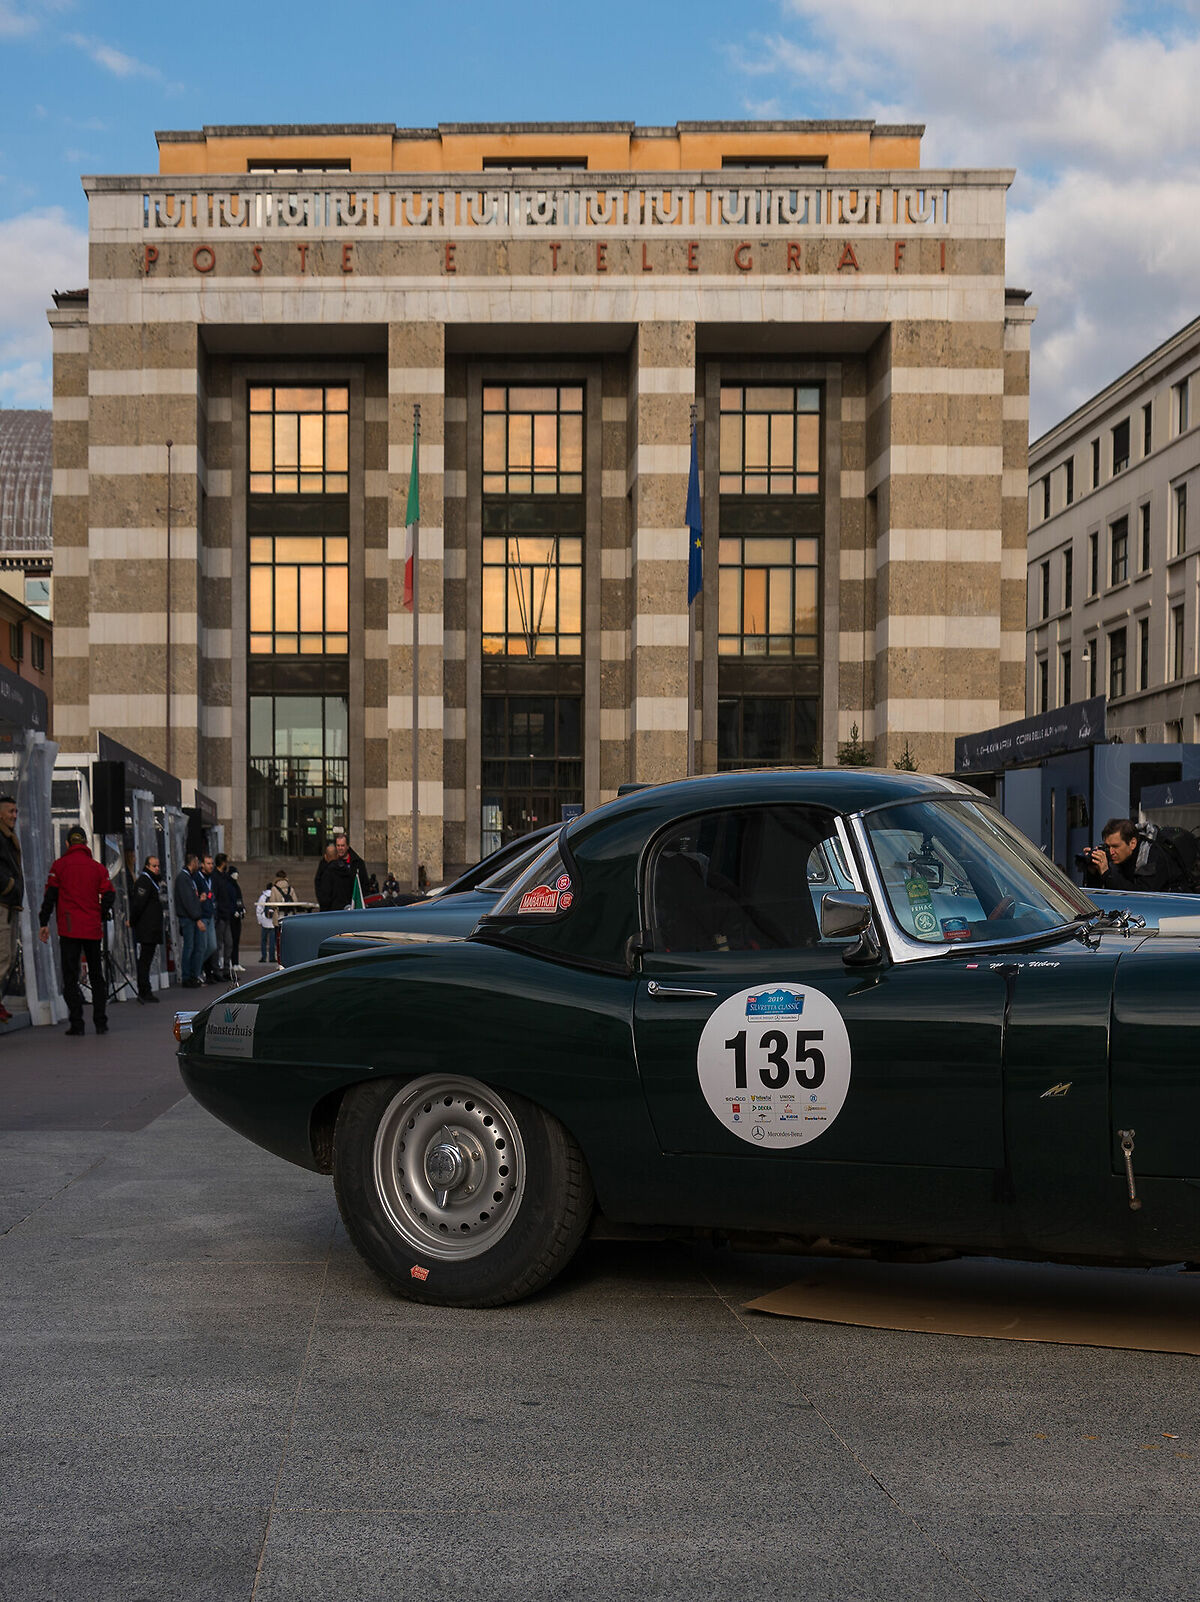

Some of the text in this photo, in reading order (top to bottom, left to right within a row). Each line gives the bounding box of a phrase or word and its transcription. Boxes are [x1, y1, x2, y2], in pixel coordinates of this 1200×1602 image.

[144, 241, 946, 273] POSTE E TELEGRAFI
[522, 892, 557, 908] MARATHON
[750, 1001, 800, 1011] SILVRETTA CLASSIC
[206, 1023, 253, 1037] Munsterhuis
[725, 1030, 826, 1089] 135
